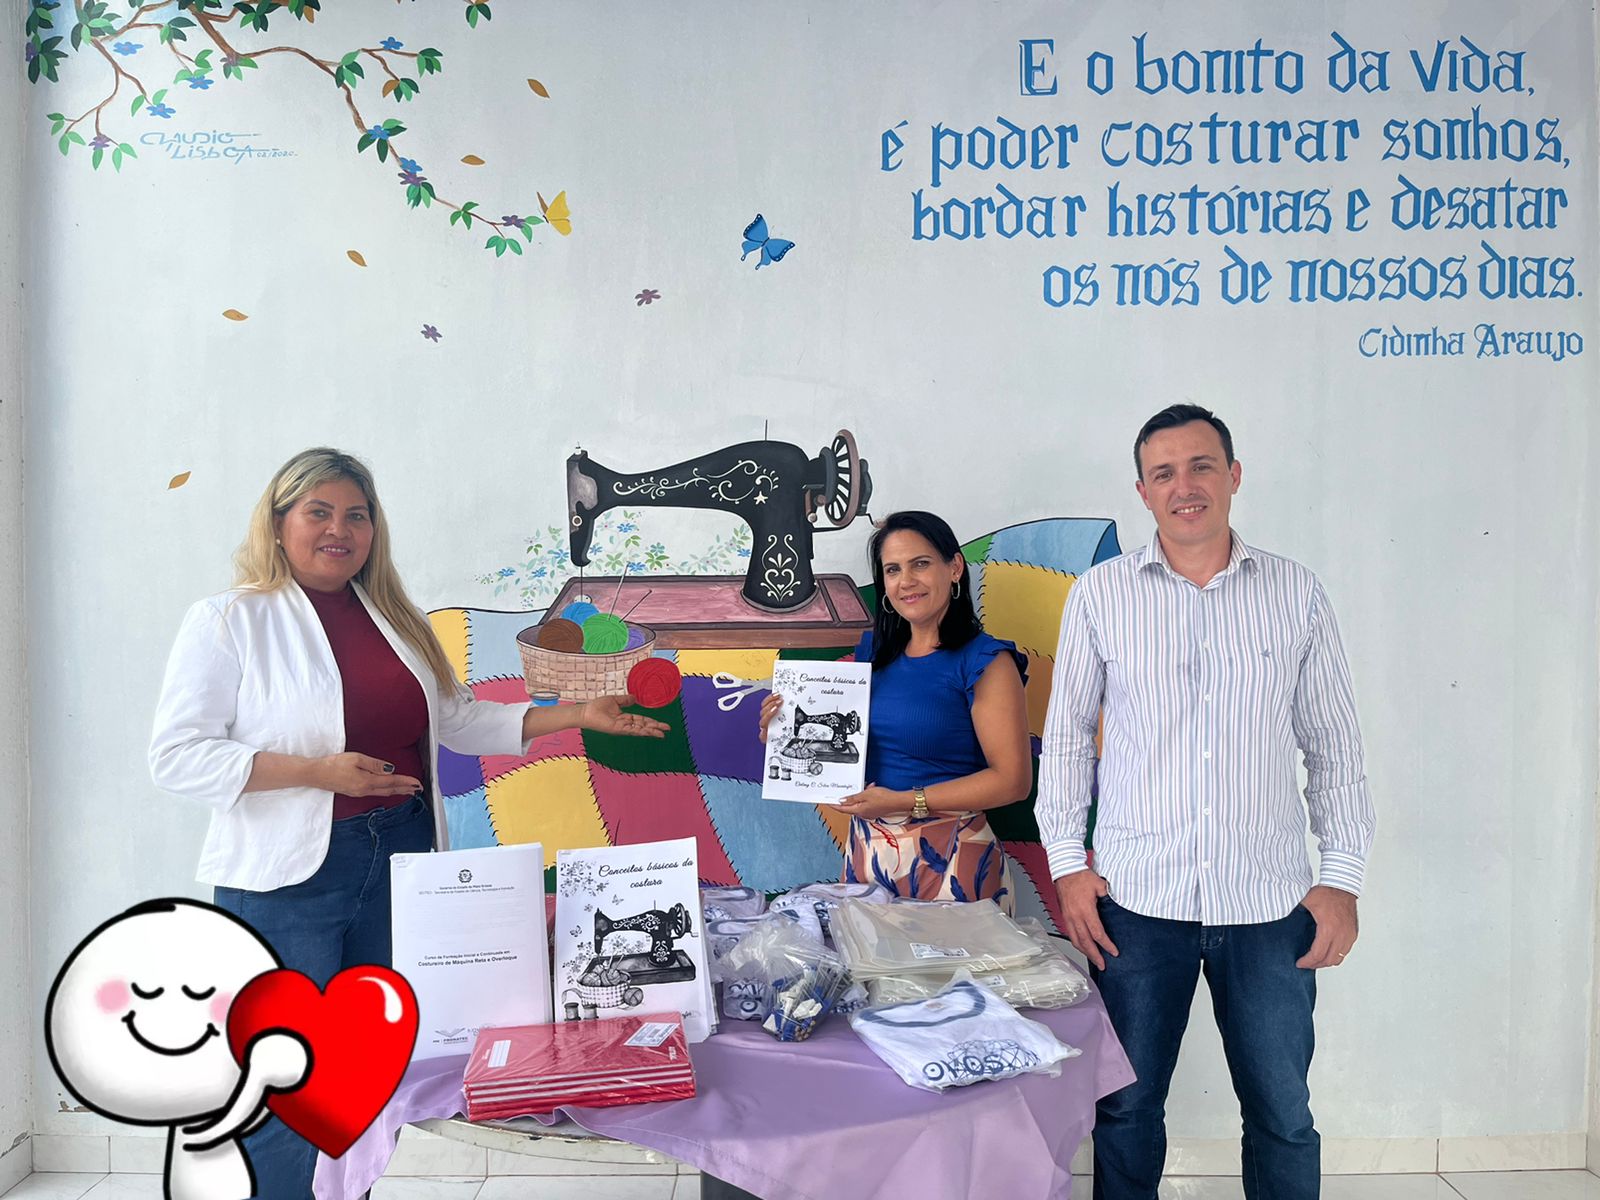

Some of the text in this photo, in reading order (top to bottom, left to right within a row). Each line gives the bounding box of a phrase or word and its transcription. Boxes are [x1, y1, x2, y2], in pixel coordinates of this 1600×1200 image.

[1019, 38, 1058, 97] E
[1087, 51, 1114, 96] o
[1132, 32, 1305, 96] bonito
[1329, 31, 1389, 94] da
[881, 105, 1570, 188] é poder costurar sonhos,
[912, 174, 1569, 241] bordar histórias e desatar
[1042, 241, 1584, 308] os nós de nossos dias.
[1358, 323, 1584, 362] Cidinha Araujo
[800, 673, 831, 683] Conceitos
[598, 858, 693, 877] Conceitos básicos da
[629, 878, 663, 888] costura
